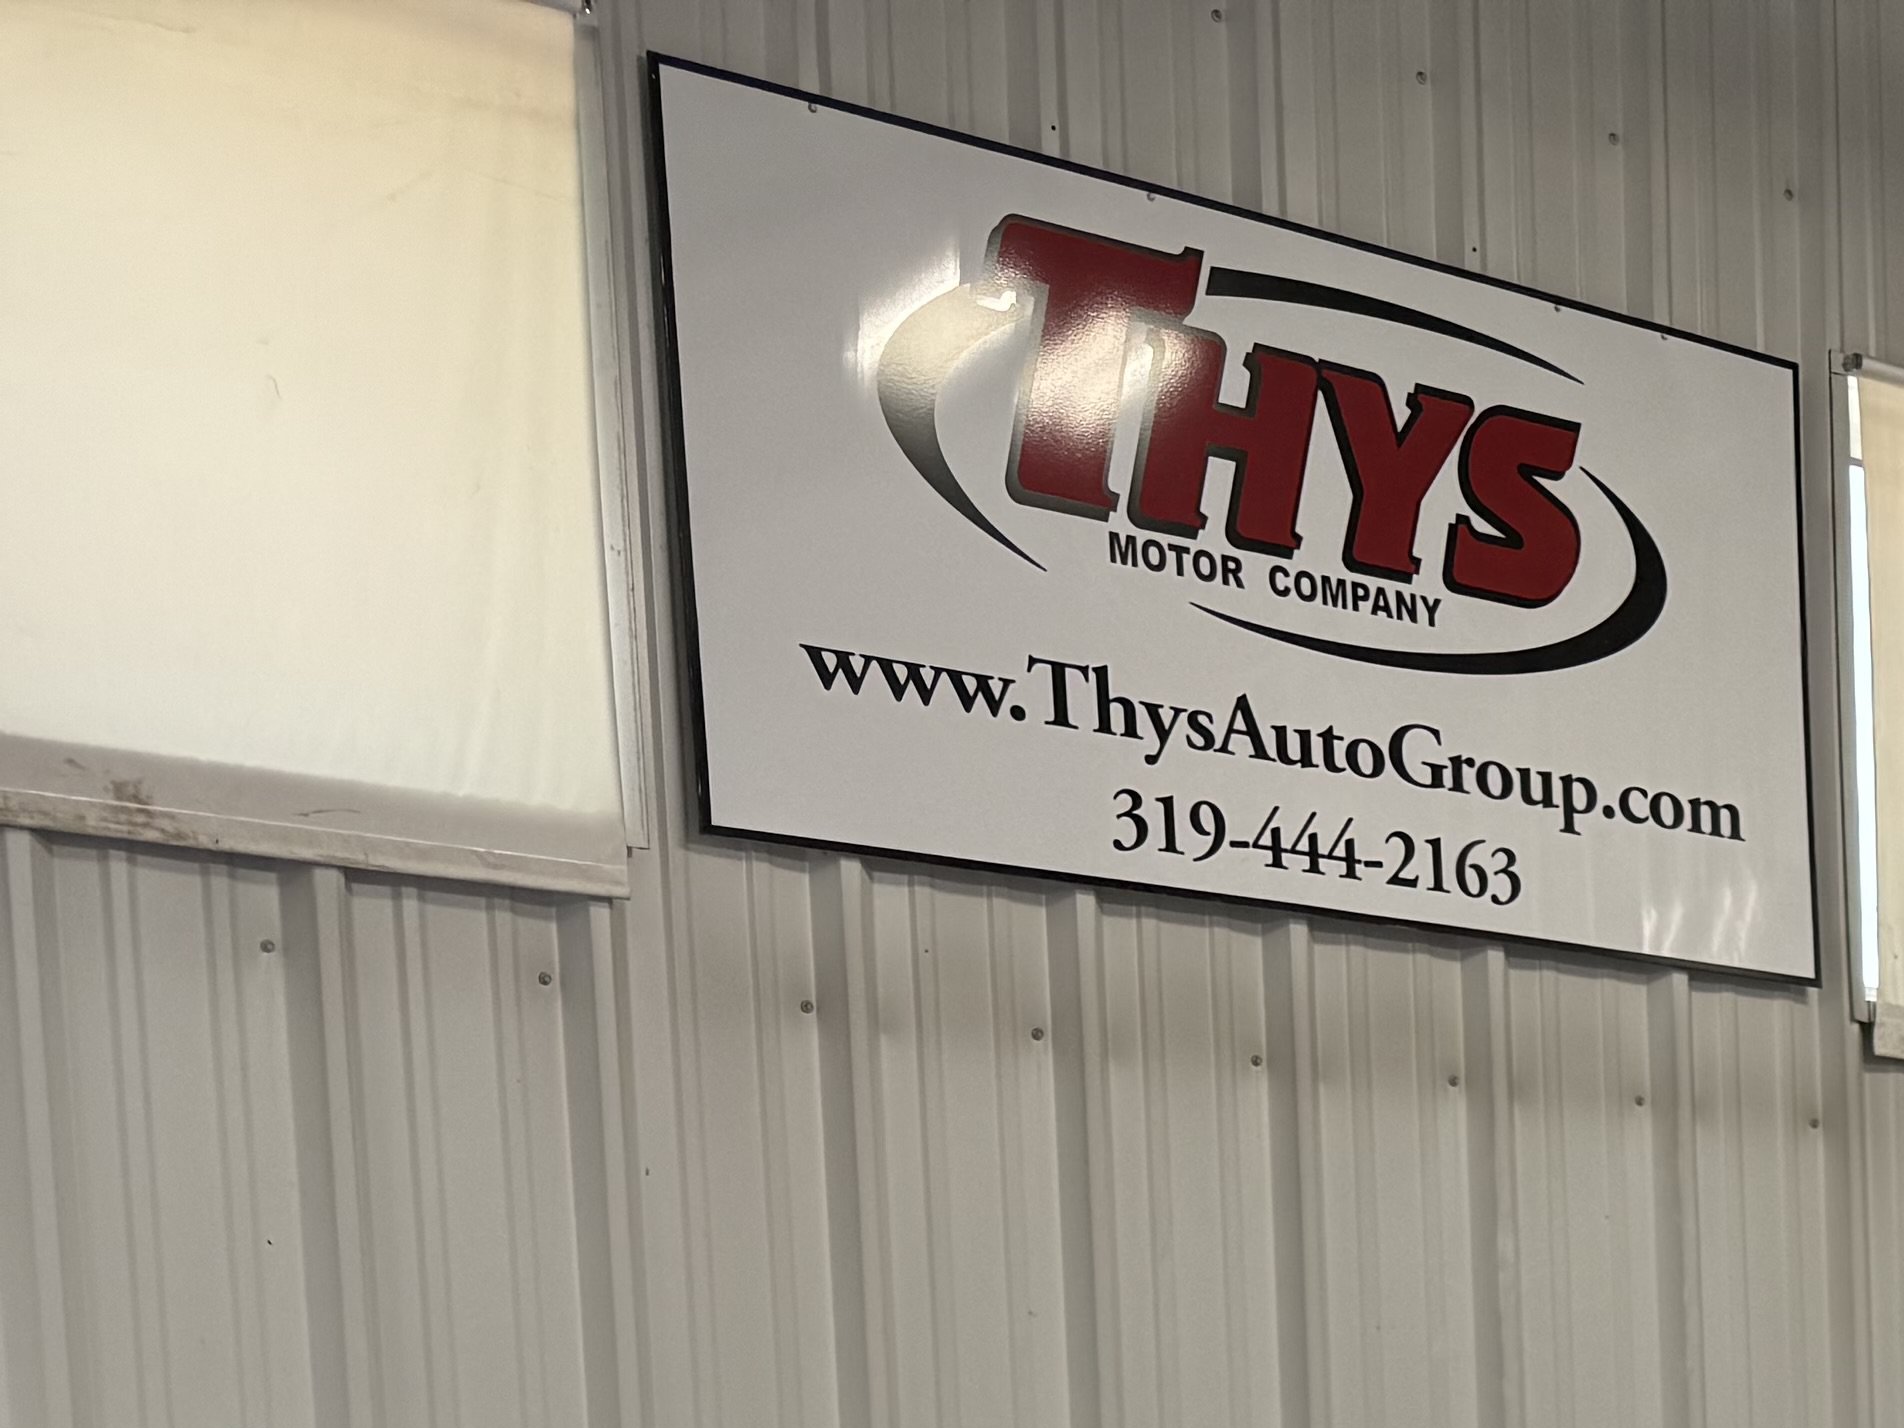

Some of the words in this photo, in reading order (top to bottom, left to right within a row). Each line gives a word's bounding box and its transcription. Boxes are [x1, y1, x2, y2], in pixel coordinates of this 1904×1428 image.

[1107, 530, 1246, 590] MOTOR
[1267, 565, 1443, 628] COMPANY
[799, 644, 1746, 843] www.ThysAutoGroup.com
[1111, 787, 1523, 905] 319-444-2163
